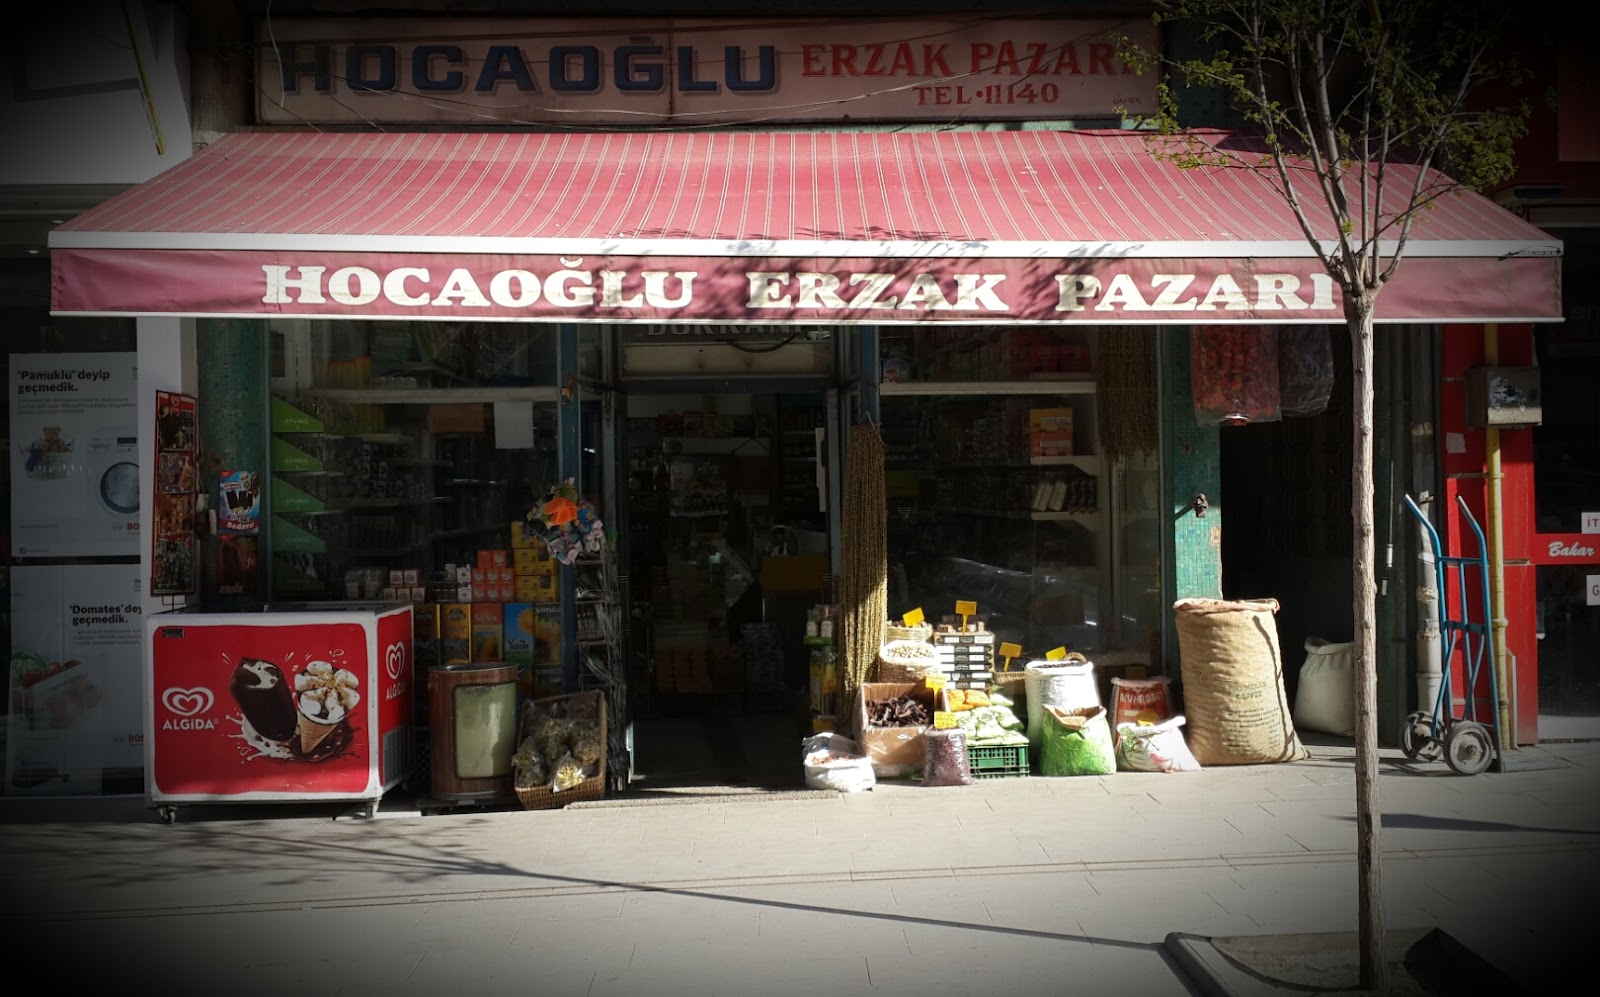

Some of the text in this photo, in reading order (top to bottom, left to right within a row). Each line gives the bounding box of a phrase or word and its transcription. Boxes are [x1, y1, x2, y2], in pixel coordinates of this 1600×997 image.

[281, 37, 777, 95] HOCAOĞLU
[802, 40, 954, 77] ERZAK
[262, 256, 1337, 311] HOCAOĞLU ERZAK PAZARI
[78, 369, 110, 382] deyip
[17, 381, 78, 395] geçmedik.
[1548, 541, 1595, 557] Bahar
[72, 614, 128, 626] geçmedik.
